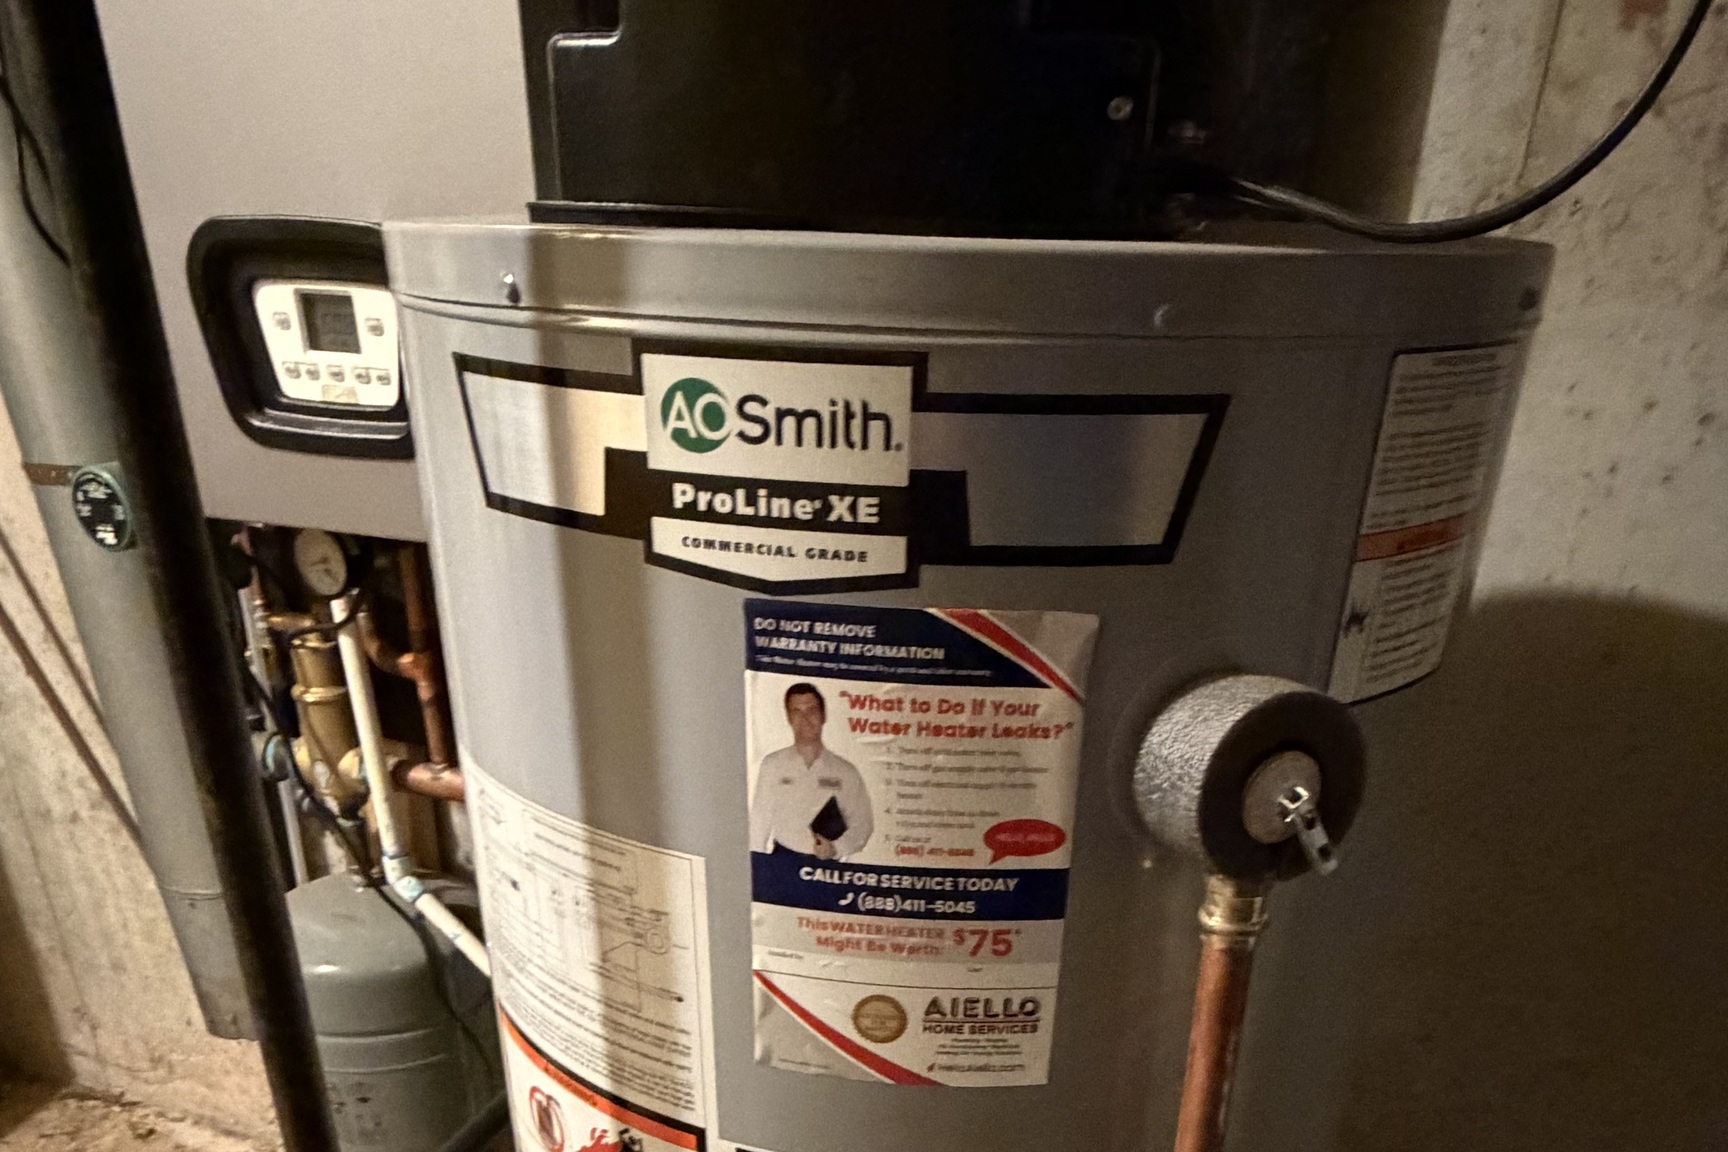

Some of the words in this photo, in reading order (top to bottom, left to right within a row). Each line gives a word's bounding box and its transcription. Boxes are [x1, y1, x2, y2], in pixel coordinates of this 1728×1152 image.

[735, 393, 893, 452] Smith
[826, 494, 881, 523] XE
[681, 535, 796, 558] COMMERCIAL
[804, 546, 869, 563] GRADE
[754, 616, 777, 631] DO
[779, 619, 811, 634] NOT
[813, 621, 877, 638] REMOVE
[755, 635, 837, 655] WARRANTY
[839, 643, 945, 660] INFORMATION
[910, 697, 931, 713] to
[936, 698, 966, 715] Do
[970, 698, 987, 716] If
[992, 699, 1041, 717] Your
[848, 716, 912, 736] Water
[916, 720, 987, 738] Heater
[799, 866, 841, 884] CALL
[843, 871, 879, 887] FOR
[880, 873, 955, 891] SERVICE
[957, 877, 1020, 892] TODAY
[797, 915, 829, 932] This
[830, 920, 886, 936] WATER
[886, 926, 945, 939] HEATER
[816, 936, 863, 954] Might
[867, 940, 887, 952] Be
[888, 941, 942, 957] Worth
[924, 996, 1041, 1018] AIELLO
[922, 1024, 964, 1034] HOME
[968, 1024, 1039, 1035] SERVICES
